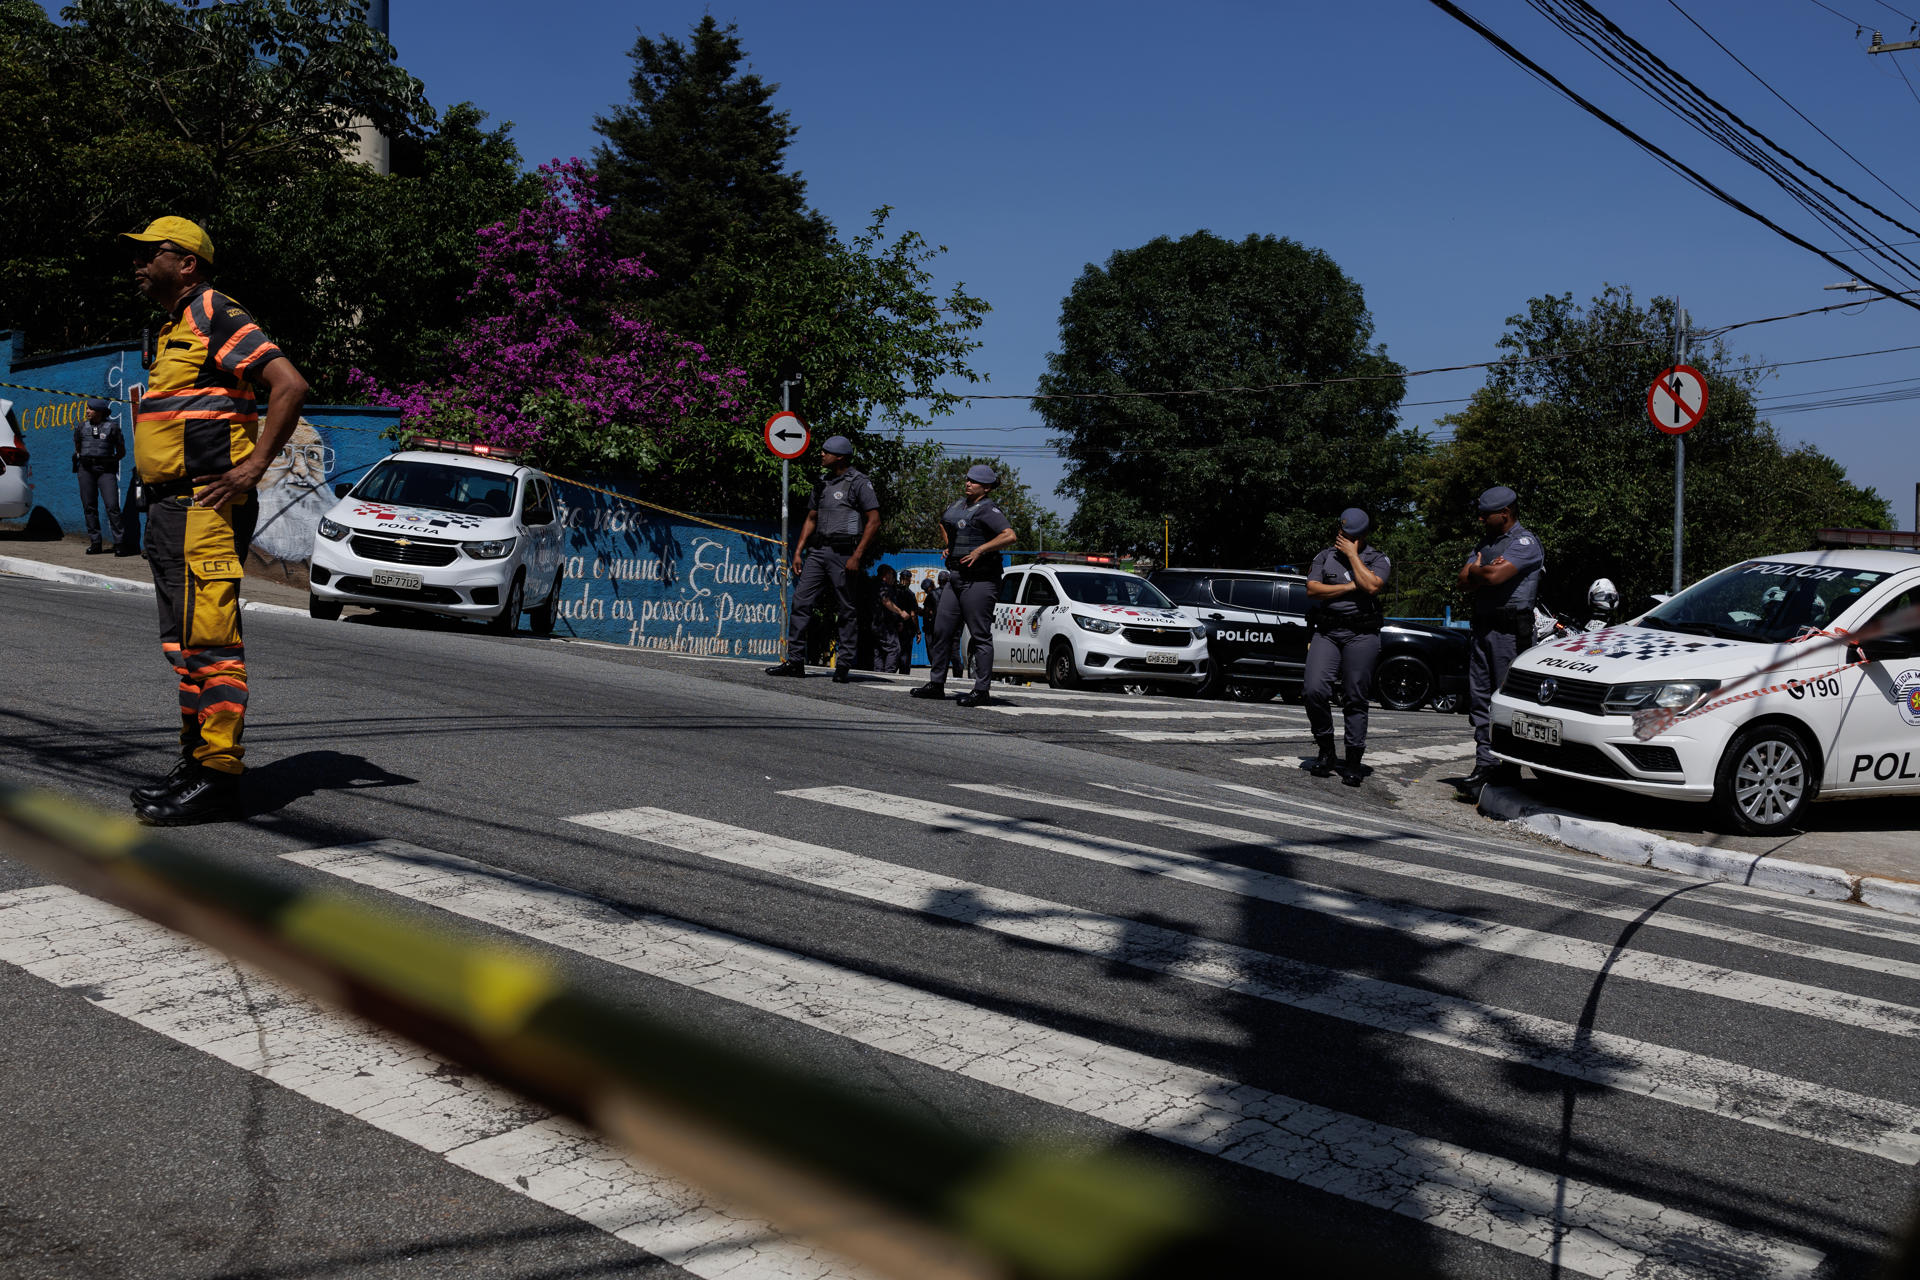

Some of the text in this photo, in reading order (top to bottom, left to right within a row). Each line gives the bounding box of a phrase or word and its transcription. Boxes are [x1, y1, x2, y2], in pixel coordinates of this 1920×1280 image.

[34, 399, 88, 430] coraça
[377, 522, 440, 535] POLÍCIA
[594, 503, 647, 532] não
[202, 560, 232, 572] CET
[593, 556, 604, 579] o
[608, 545, 680, 580] mundo.
[557, 583, 604, 620] uda
[612, 598, 634, 621] as
[1216, 629, 1275, 643] POLÍCIA
[1010, 644, 1046, 664] POLÍCIA
[1805, 678, 1839, 698] 190
[1849, 752, 1920, 783] POL
